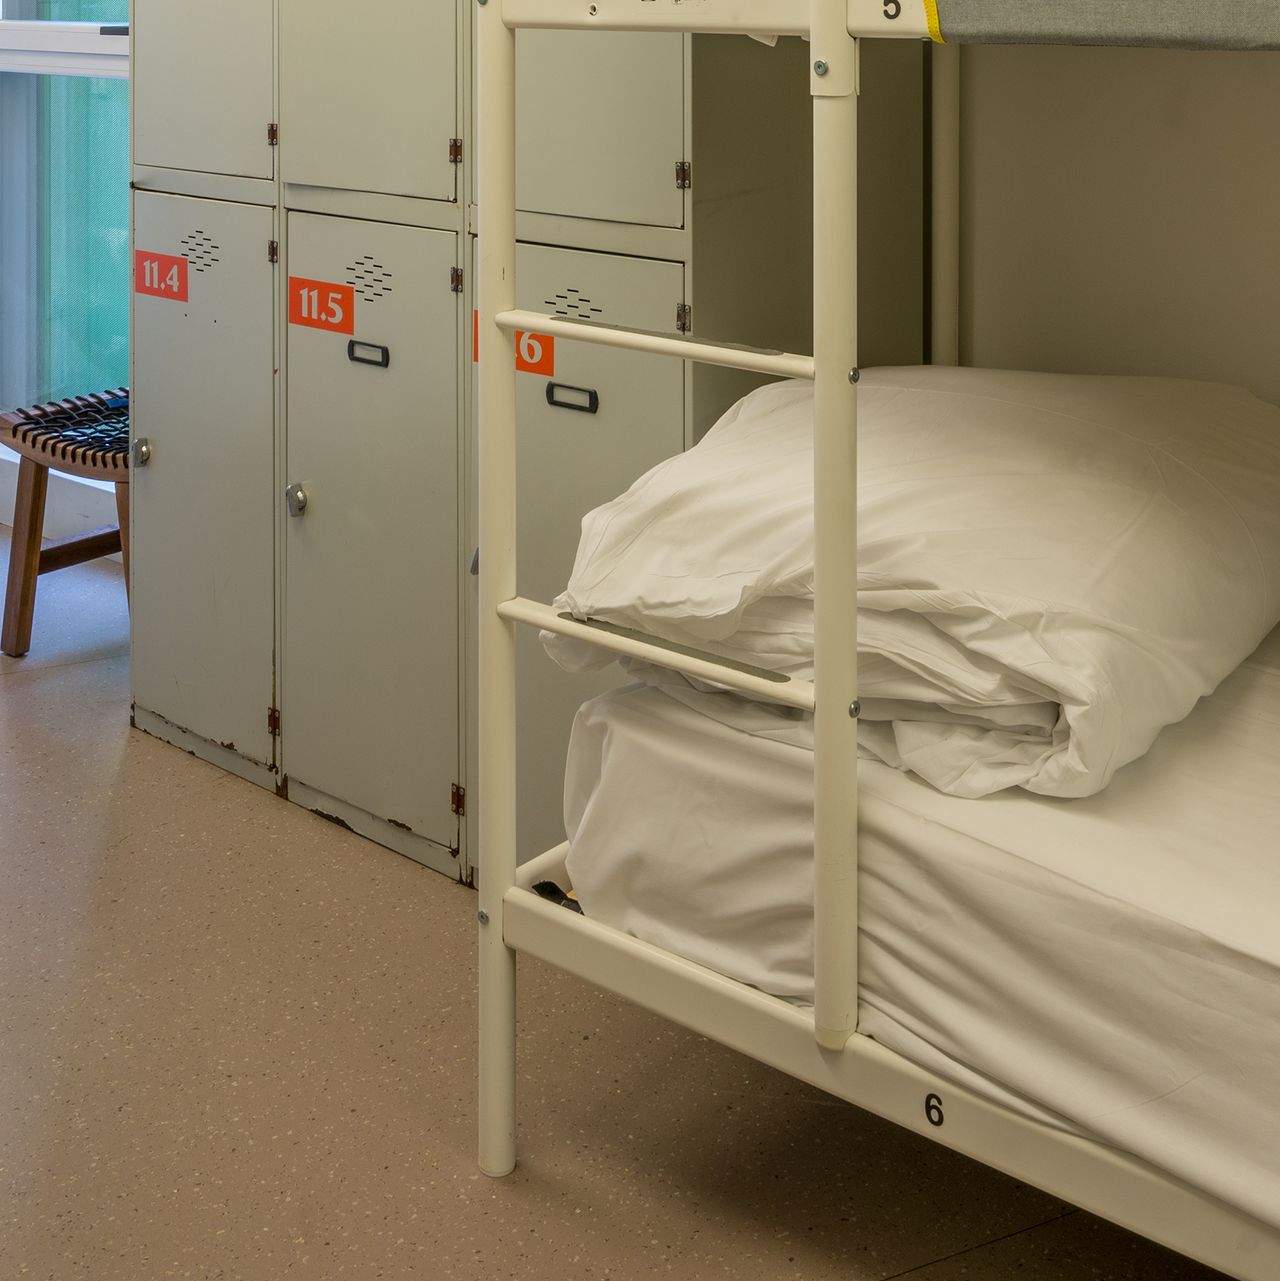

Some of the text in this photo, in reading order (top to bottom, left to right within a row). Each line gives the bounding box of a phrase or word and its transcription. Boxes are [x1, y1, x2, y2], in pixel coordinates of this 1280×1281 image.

[143, 260, 179, 293] 11.4
[299, 287, 343, 324] 11.5
[925, 1093, 944, 1127] 6
